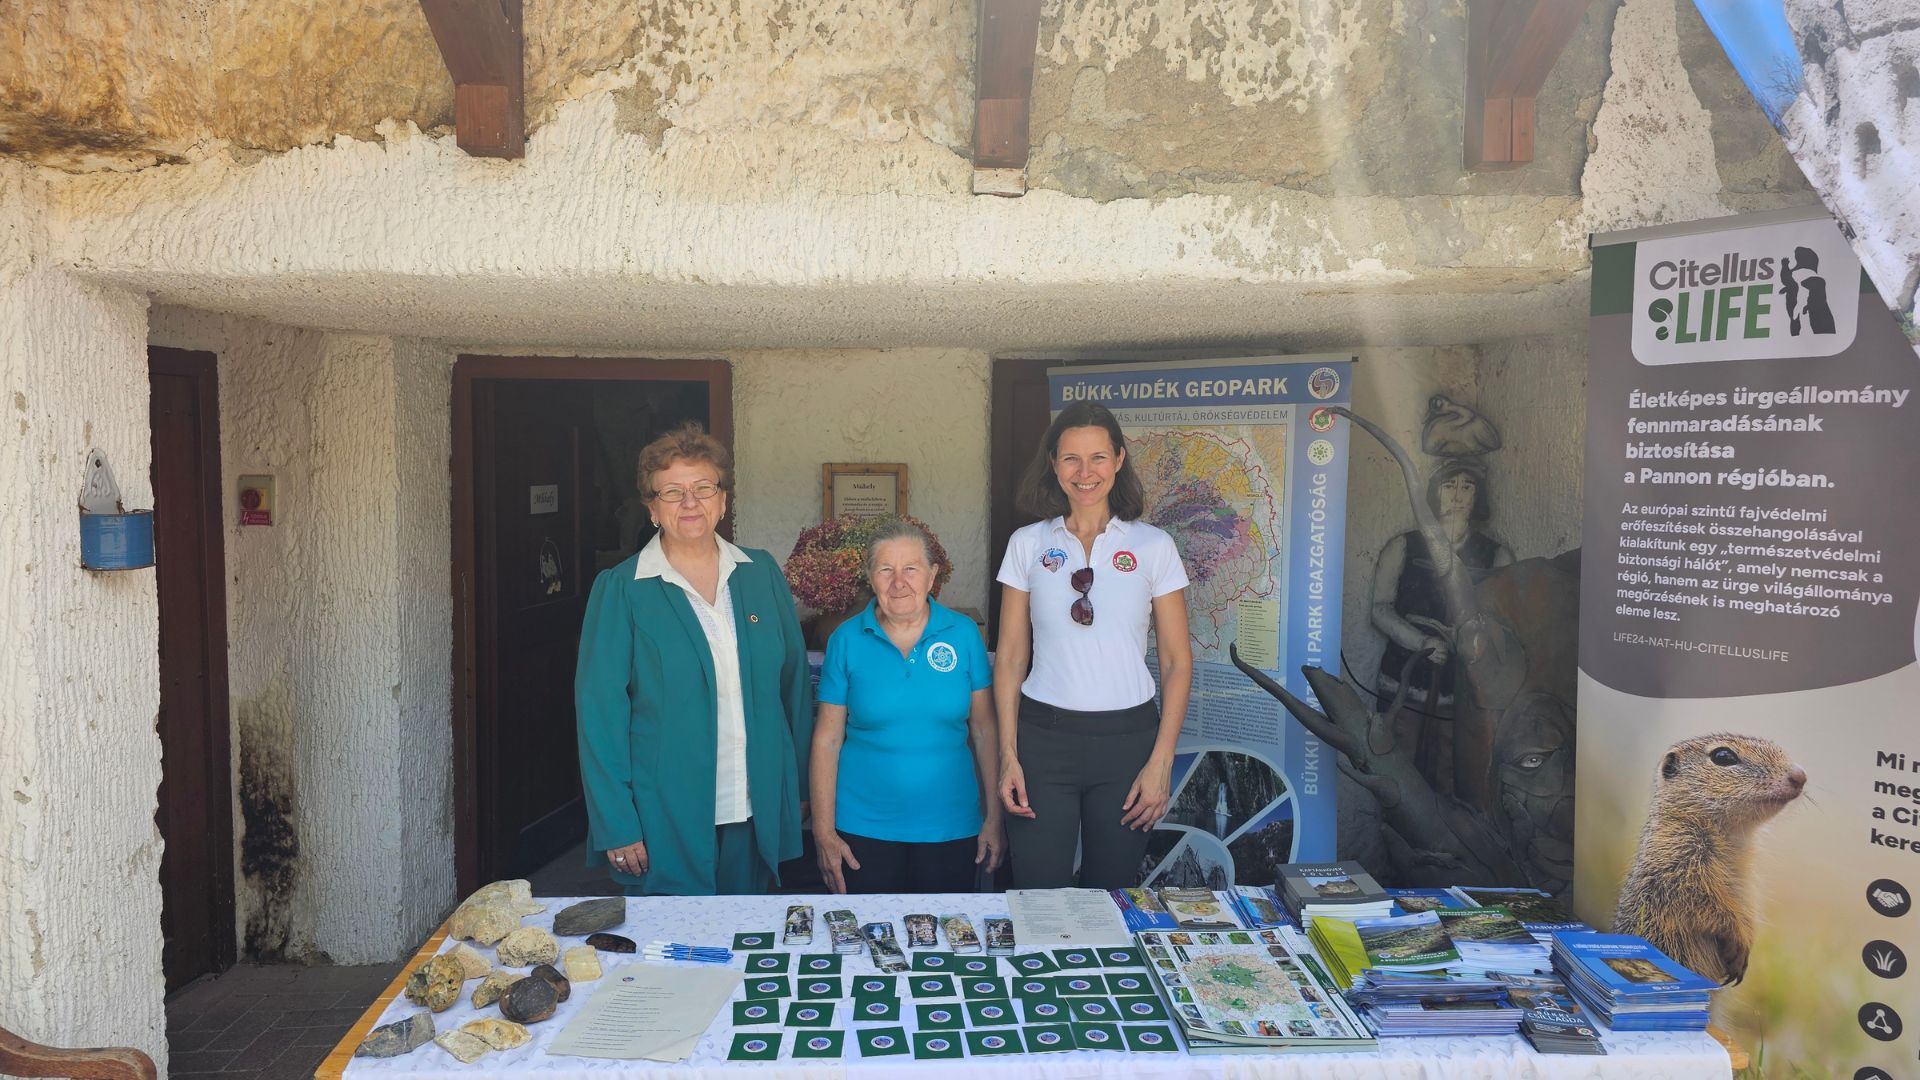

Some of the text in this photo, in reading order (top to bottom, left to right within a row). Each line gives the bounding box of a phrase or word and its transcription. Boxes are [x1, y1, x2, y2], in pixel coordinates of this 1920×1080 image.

[1649, 252, 1774, 290] Citellus
[1675, 283, 1773, 344] LIFE
[1062, 377, 1288, 401] BÜKK-VIDÉK GEOPARK
[1629, 386, 1910, 410] Életképes ürgeállomány
[1627, 414, 1823, 434] fennmaradásának
[1625, 442, 1735, 459] biztosítása
[1624, 468, 1835, 490] a Pannon régióban.
[1622, 503, 1827, 523] Az európai szintű fajvédelmi
[1308, 473, 1327, 600] IGAZGATÓSÁG
[1621, 519, 1863, 543] erőfeszítések összehangolásával
[1619, 536, 1881, 564] kialakítunk egy „természetvédelmi
[1618, 553, 1681, 570] biztonsági
[1737, 564, 1787, 579] amely
[1790, 566, 1868, 583] nemcsak
[1872, 572, 1884, 584] a
[1617, 570, 1893, 604] régió, hanem az ürge világállománya
[1615, 605, 1681, 622] eleme lesz.
[1616, 588, 1841, 618] megőrzésének is meghatározó
[1307, 605, 1322, 653] PARK
[1613, 631, 1789, 662] LIFE24-NAT-HU-CITELLUSLIFE
[1301, 741, 1319, 795] BÜKKI
[1876, 750, 1906, 771] Mi
[1872, 806, 1920, 826] a Ci
[1870, 827, 1920, 853] kere
